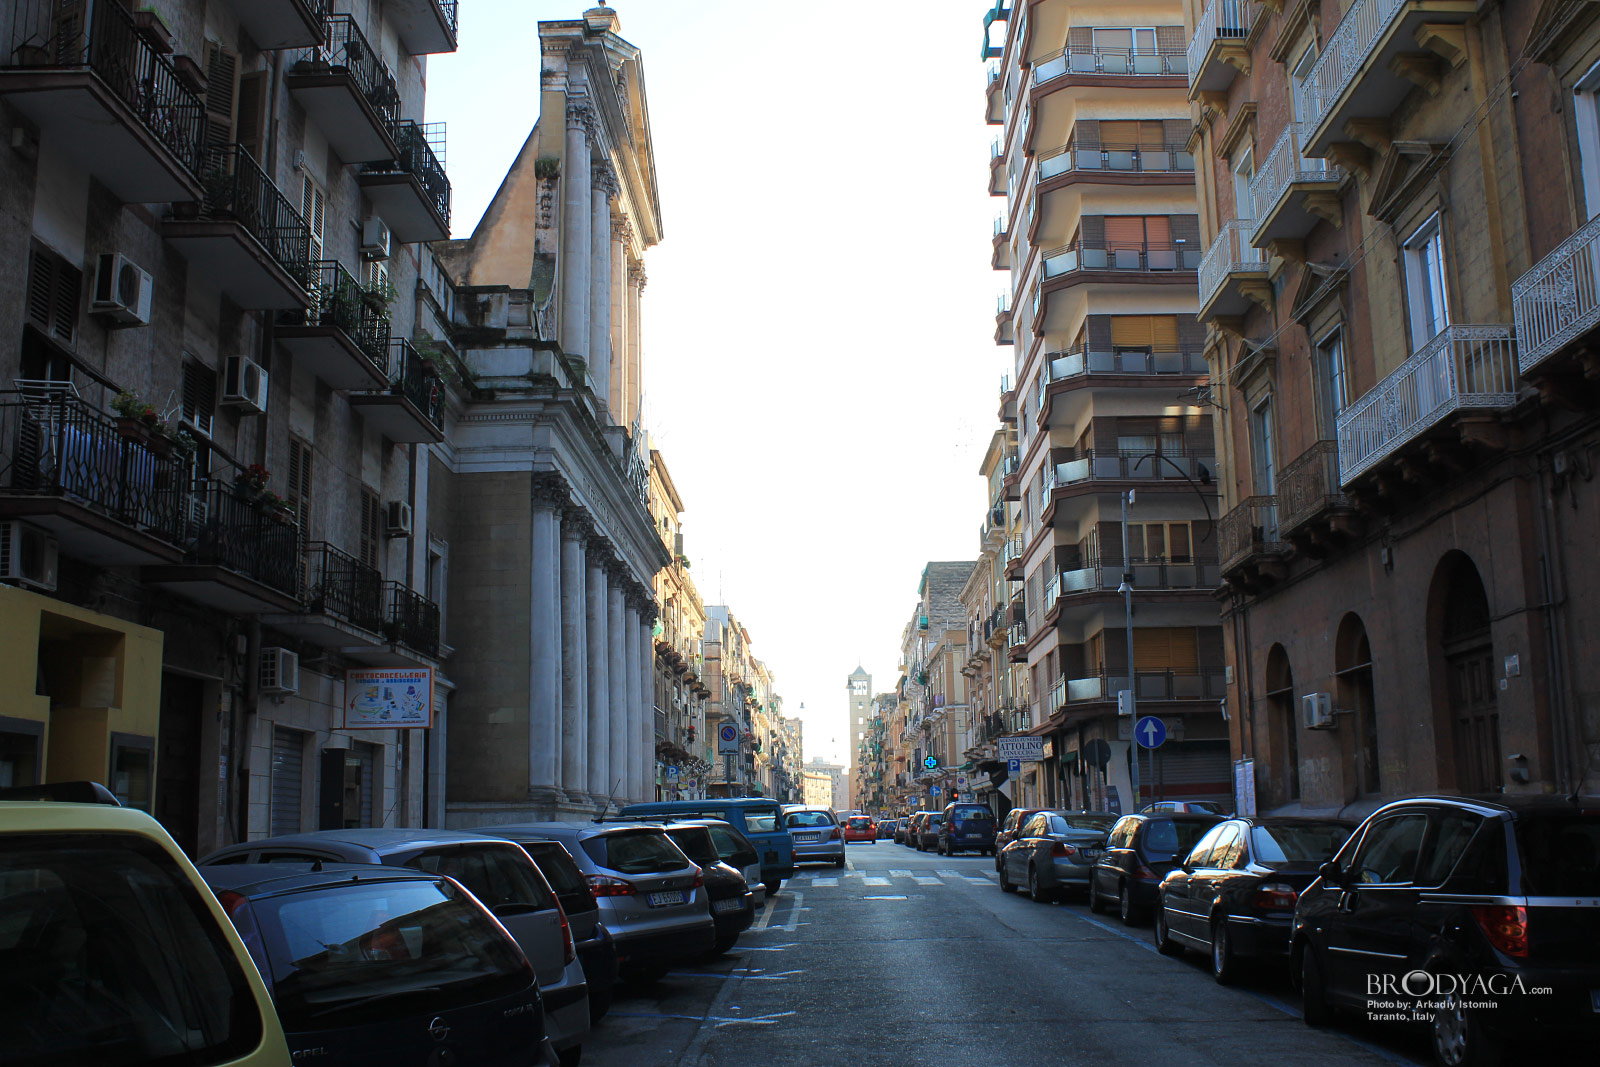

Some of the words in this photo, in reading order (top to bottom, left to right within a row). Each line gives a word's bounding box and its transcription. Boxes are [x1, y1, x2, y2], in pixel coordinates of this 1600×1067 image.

[1000, 742, 1042, 750] ATTOLINO
[1011, 760, 1018, 770] P
[668, 767, 677, 777] P
